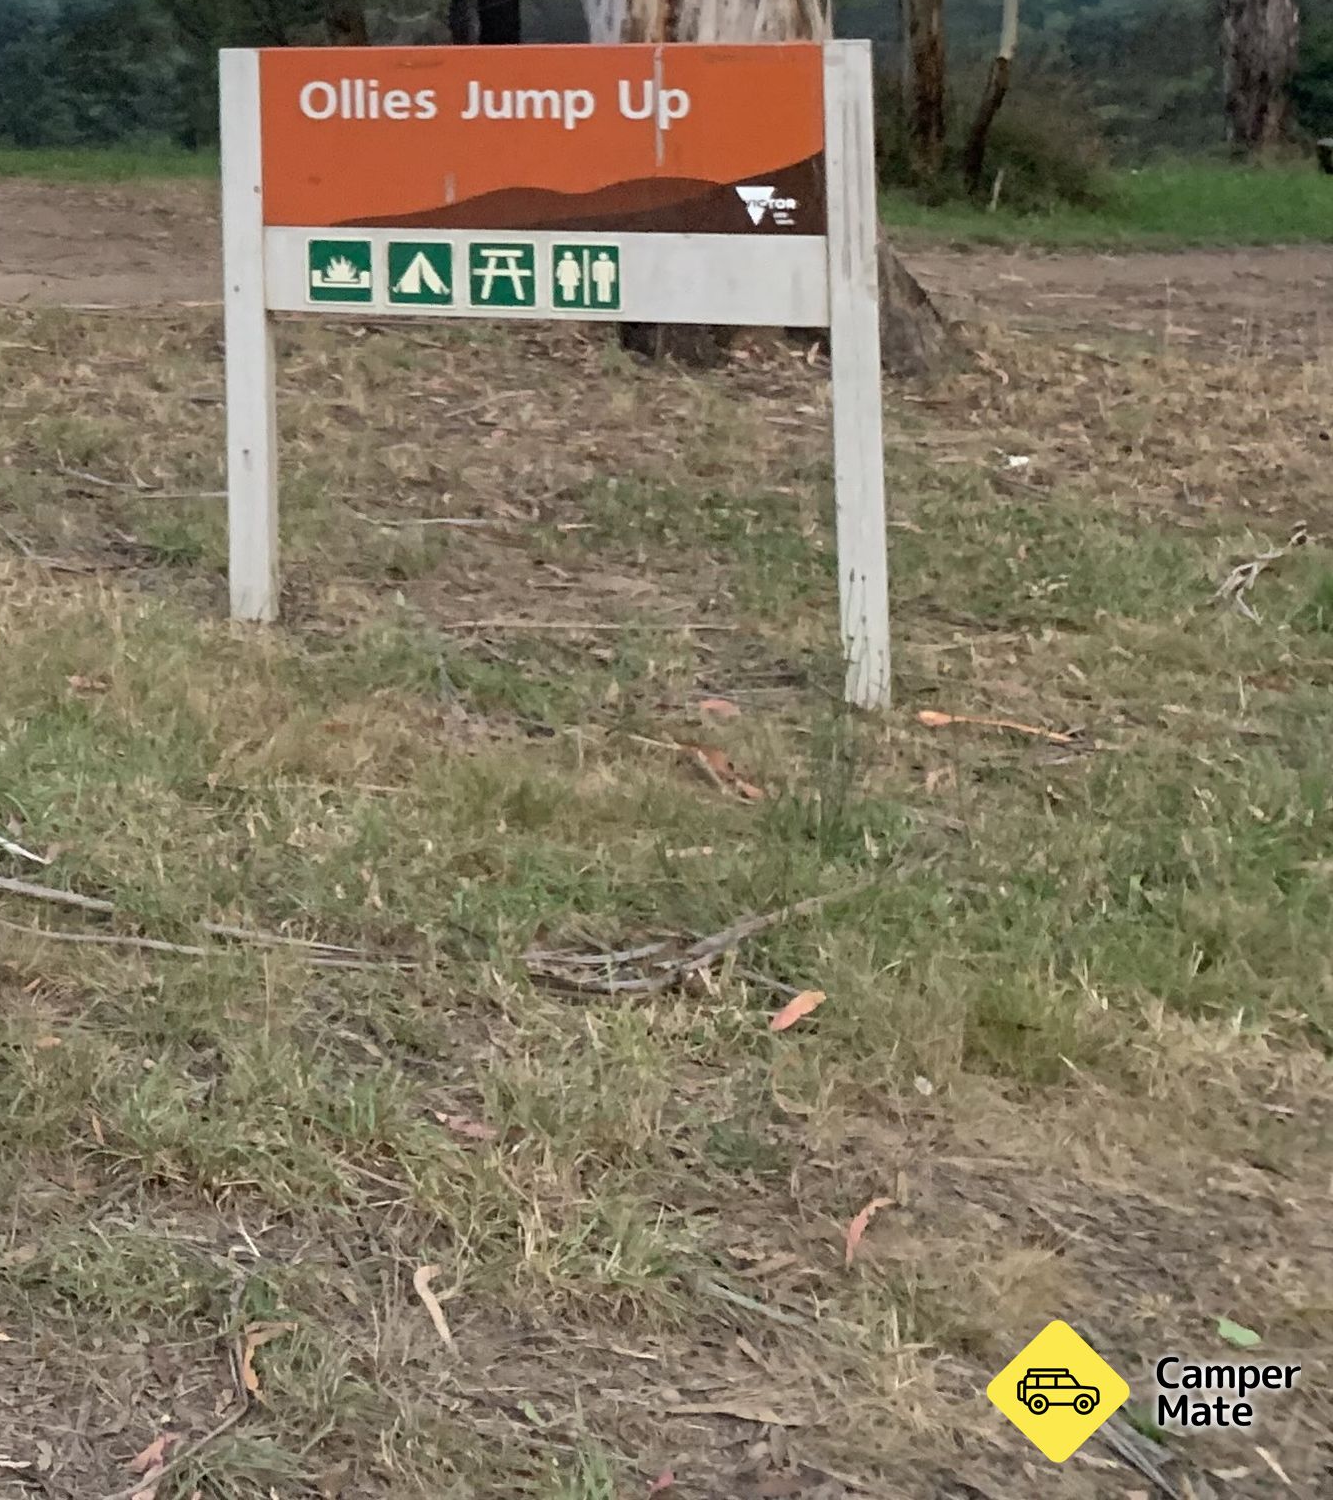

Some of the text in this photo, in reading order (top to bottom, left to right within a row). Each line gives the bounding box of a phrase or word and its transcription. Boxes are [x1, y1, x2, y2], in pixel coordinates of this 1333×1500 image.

[300, 79, 690, 130] Ollies Jump Up
